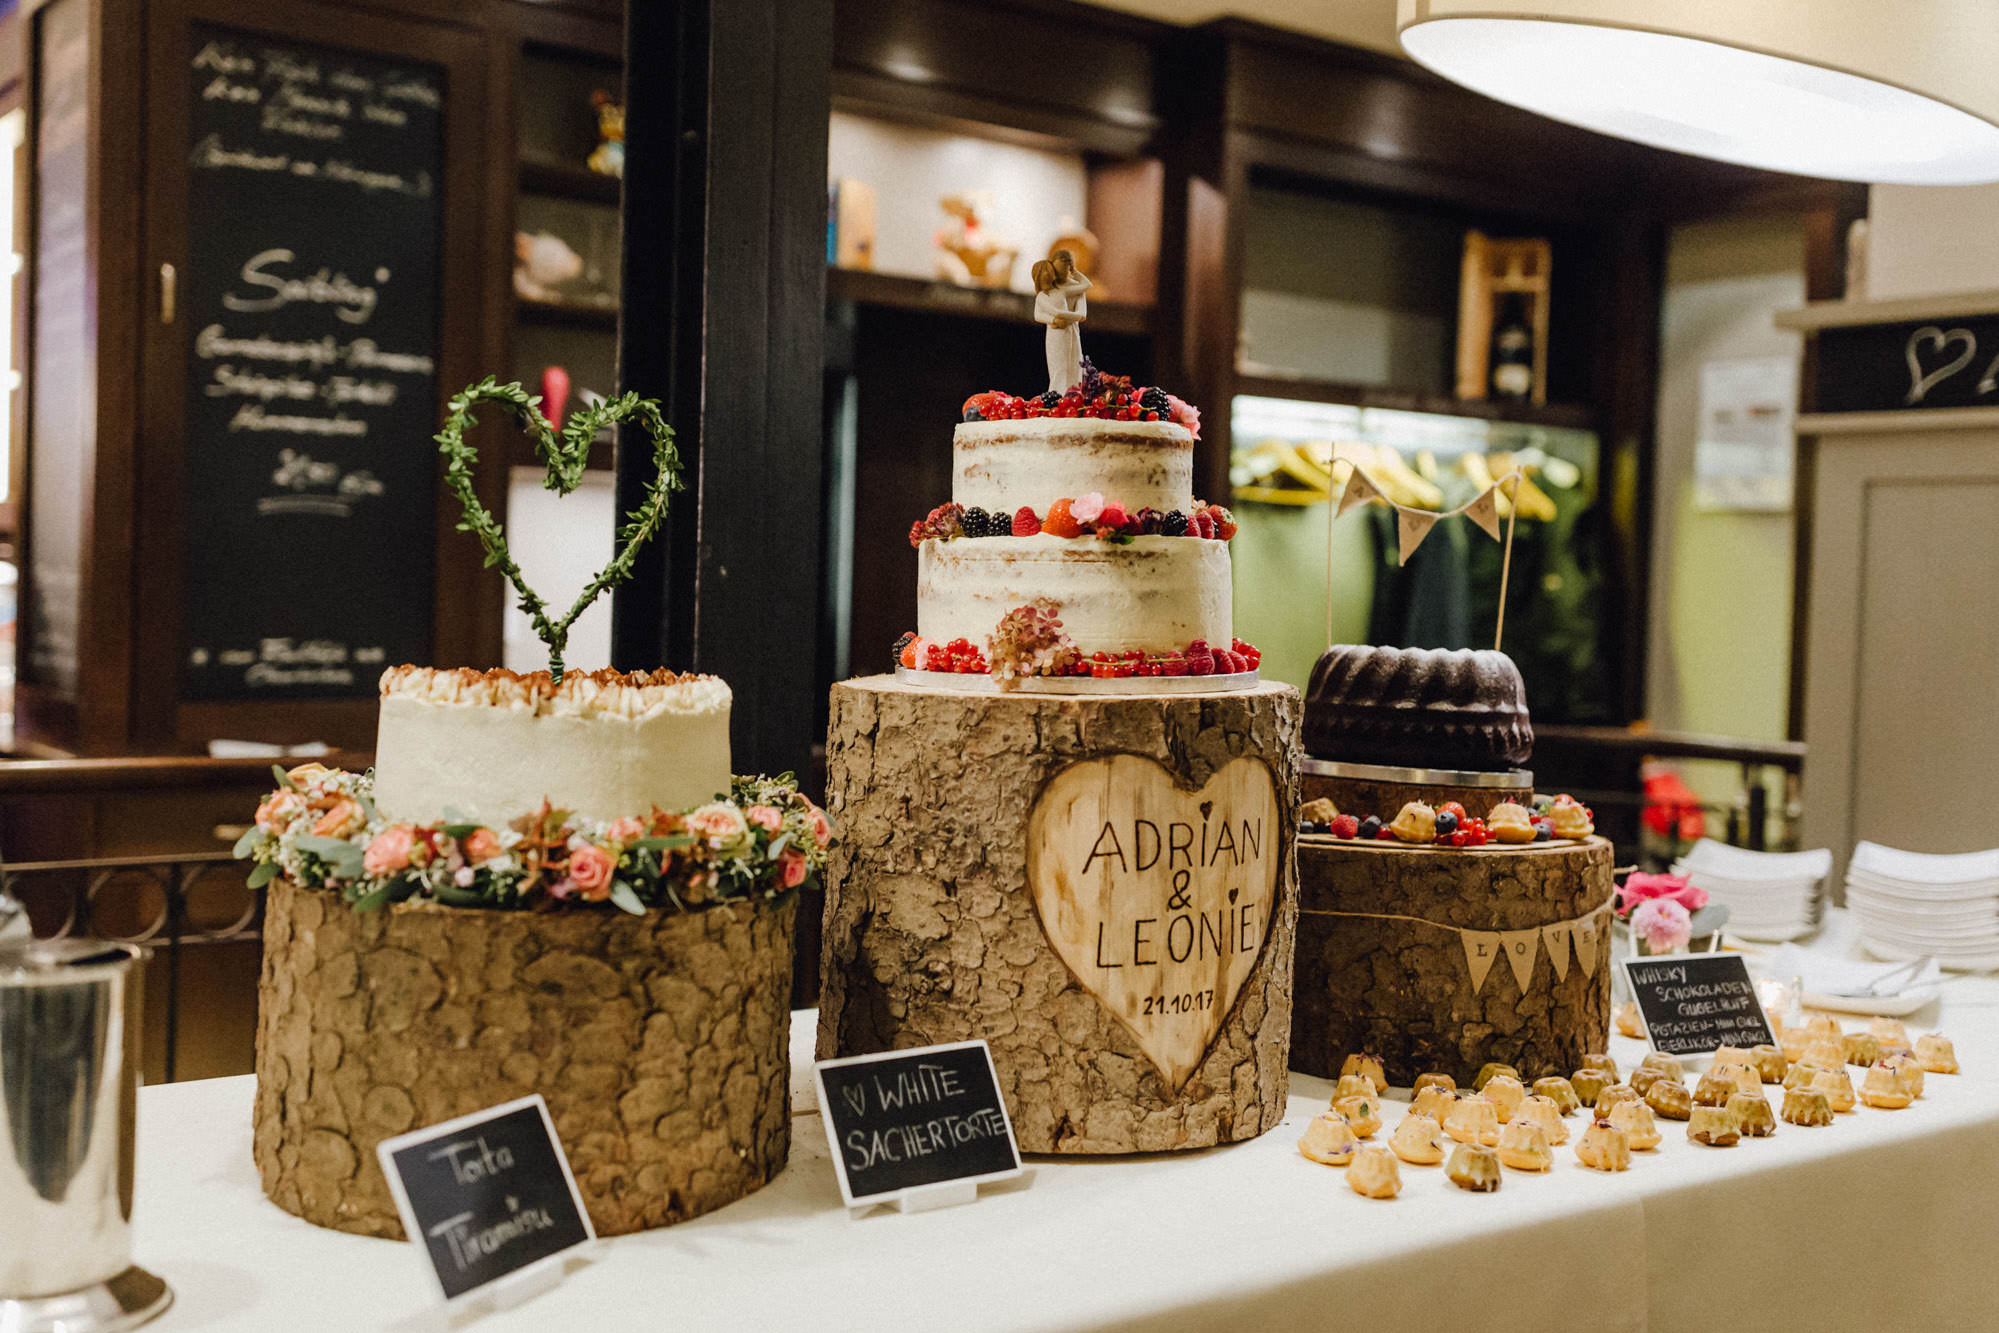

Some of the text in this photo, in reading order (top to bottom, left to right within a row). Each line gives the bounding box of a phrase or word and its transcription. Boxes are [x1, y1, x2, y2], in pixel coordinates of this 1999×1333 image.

[1081, 801, 1261, 875] ADRIAN
[1166, 869, 1193, 911] &
[1096, 888, 1256, 968] LEONIE
[1631, 965, 1687, 985] WHISKY
[1655, 980, 1753, 1003] SCHOKOLADEN
[1142, 990, 1214, 1016] 21.10.17
[873, 1063, 966, 1113] WHITE
[846, 1107, 1009, 1172] SACHERTORTE
